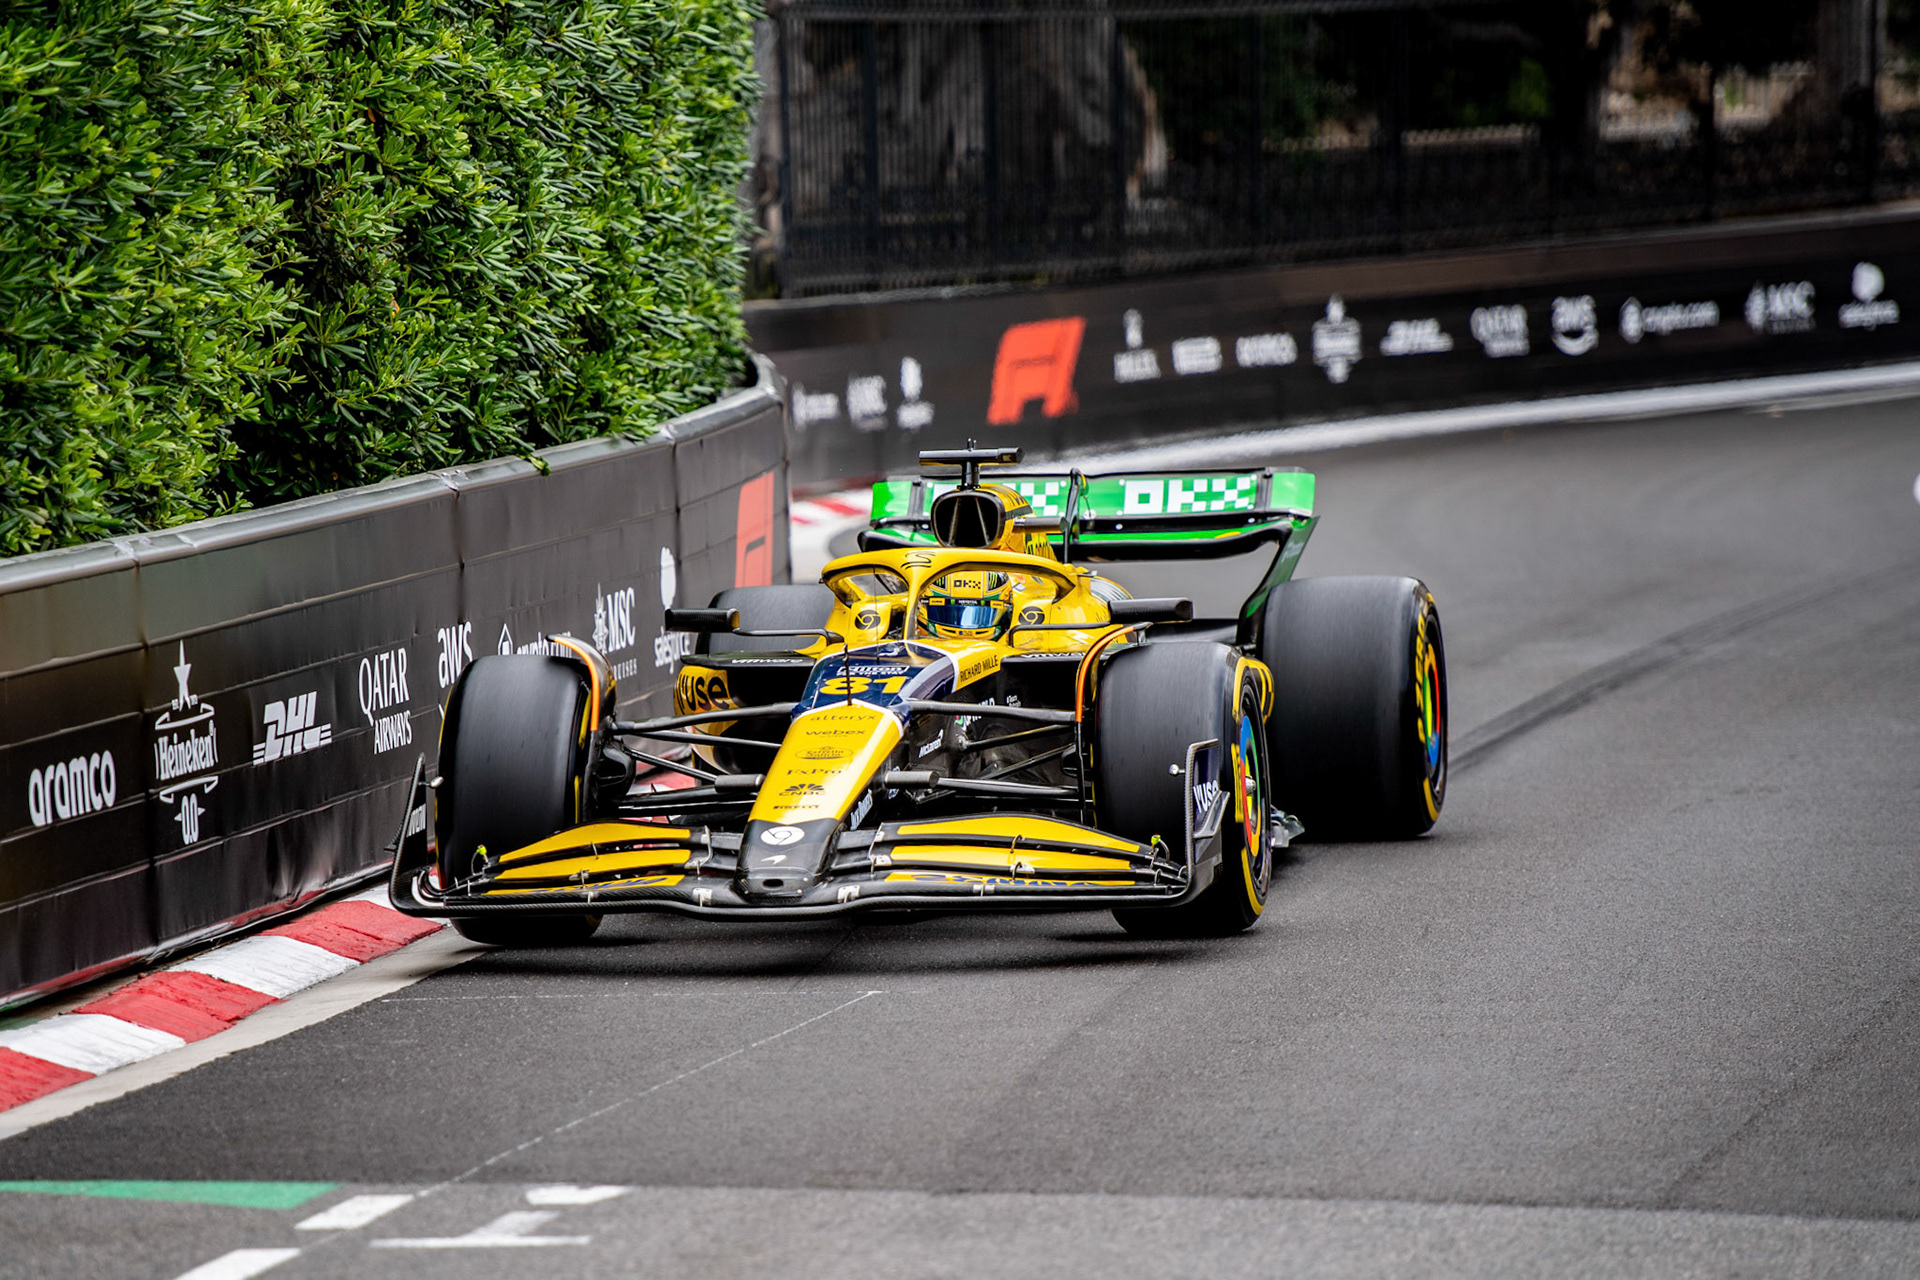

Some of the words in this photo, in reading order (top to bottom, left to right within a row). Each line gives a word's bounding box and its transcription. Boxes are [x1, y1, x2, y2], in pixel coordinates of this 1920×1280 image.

[1123, 477, 1251, 514] OKX
[953, 580, 981, 589] OKX
[607, 587, 637, 653] MSC
[437, 621, 473, 688] aws
[959, 662, 982, 683] RICHARD
[982, 654, 999, 671] MILLE
[358, 647, 410, 727] QATAR
[819, 676, 907, 695] 81
[263, 691, 323, 763] DHL
[373, 710, 413, 755] AIRWAYS
[158, 727, 214, 782] Heineken
[28, 749, 117, 828] aramco
[181, 793, 199, 845] 0.0
